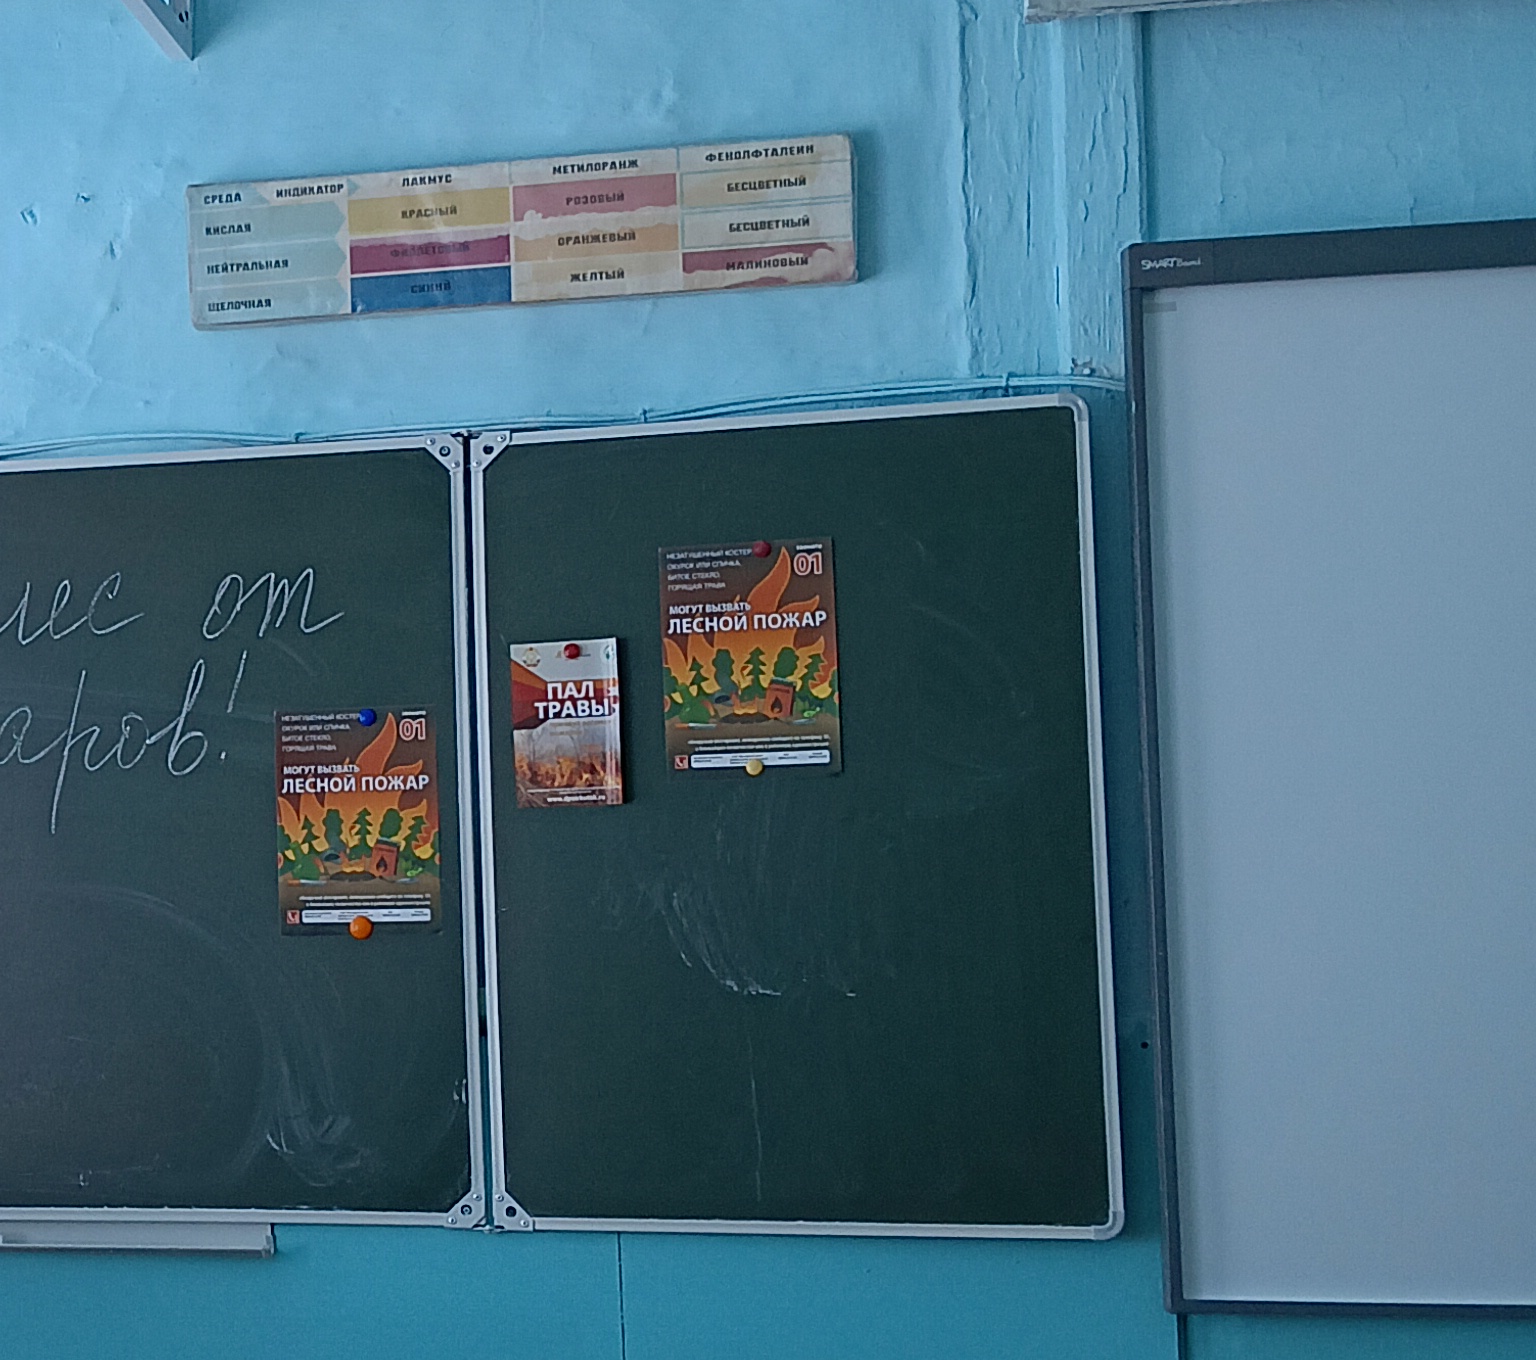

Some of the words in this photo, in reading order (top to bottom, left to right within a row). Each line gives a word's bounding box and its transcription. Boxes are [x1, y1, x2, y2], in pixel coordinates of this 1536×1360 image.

[705, 144, 814, 162] ФЕНОЛФТАЛЕИН
[552, 159, 639, 175] МЕТИЛОРАНЖ
[402, 174, 452, 187] ЛАКМУС
[727, 175, 806, 192] БЕСЦВЕТНЫЙ
[204, 193, 242, 205] СРЕДА
[276, 184, 344, 198] ИНДИКАТОР
[566, 192, 624, 206] РОЗОВЫЙ
[401, 205, 457, 219] КРАСНЫЙ
[205, 223, 251, 235] КИСЛАЯ
[729, 215, 810, 233] БЕСЦВЕТНЫЙ
[558, 230, 636, 246] ОРАНЖЕВЫЙ
[207, 258, 289, 274] НЕЙТРАЛЬНАЯ
[726, 256, 809, 271] МАЛИНОВЫЙ
[570, 267, 625, 282] ЖЕЛТЫЙ
[411, 281, 451, 294] СИНИЙ
[208, 299, 272, 312] ЩЕЛОЧНАЯ
[793, 552, 823, 576] 01
[202, 566, 344, 640] от
[669, 604, 703, 615] МОГУТ
[705, 602, 751, 613] ВЫЗВАТЬ
[668, 613, 748, 634] ЛЕСНОЙ
[754, 610, 827, 629] ПОЖАР
[547, 681, 594, 700] ПАЛ
[534, 698, 610, 719] ТРАВЫ
[399, 718, 426, 741] 01
[283, 766, 315, 775] МОГУТ
[317, 764, 360, 774] ВЫЗВАТЬ
[281, 774, 356, 794] ЛЕСНОЙ
[361, 774, 429, 792] ПОЖАР
